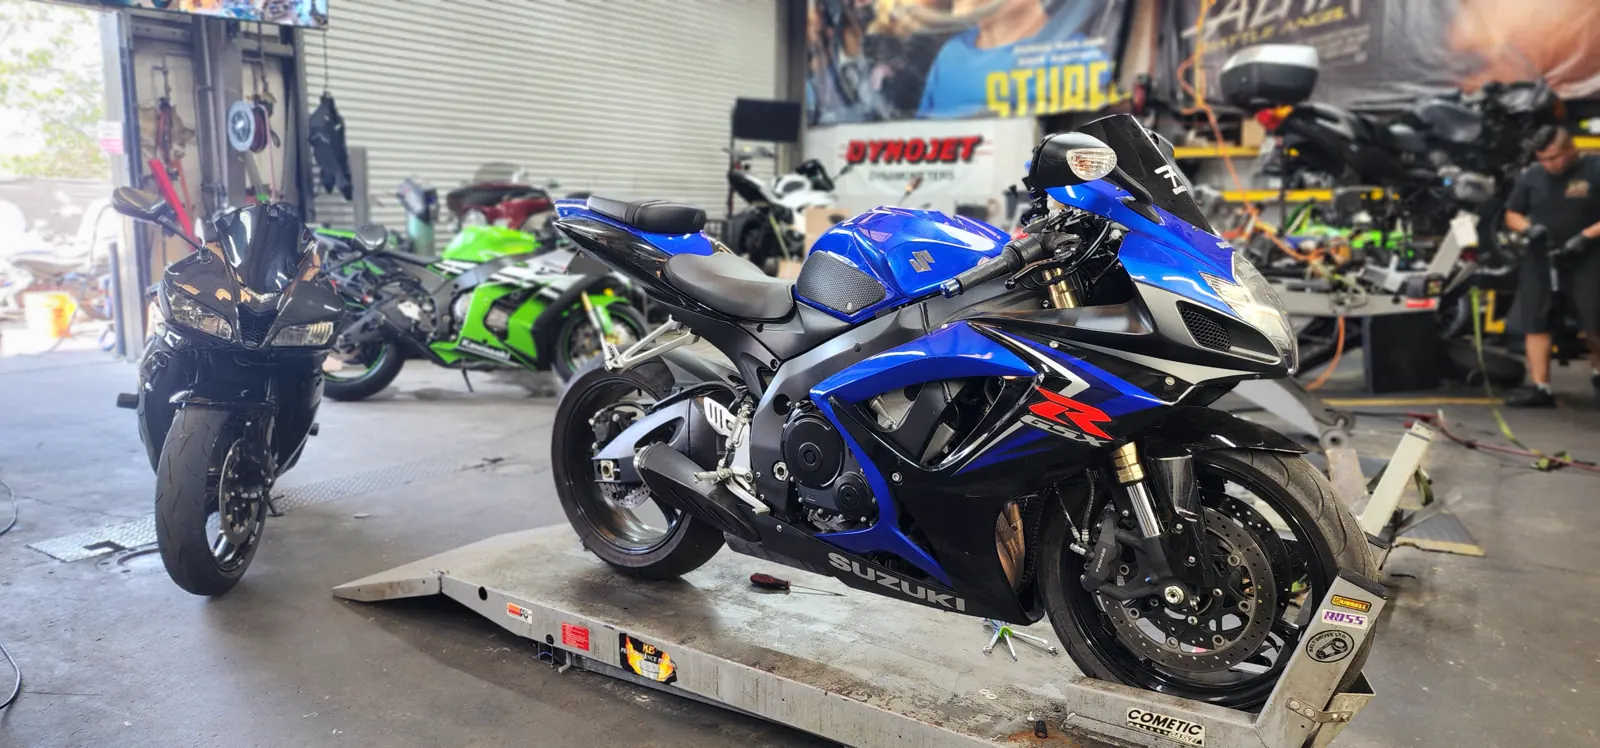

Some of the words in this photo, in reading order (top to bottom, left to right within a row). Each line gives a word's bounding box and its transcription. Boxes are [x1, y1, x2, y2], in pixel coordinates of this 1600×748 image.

[846, 136, 983, 163] DYNOJET
[1020, 414, 1110, 447] GSX
[828, 552, 966, 612] SUZUKI
[1128, 709, 1203, 735] COMETIC
